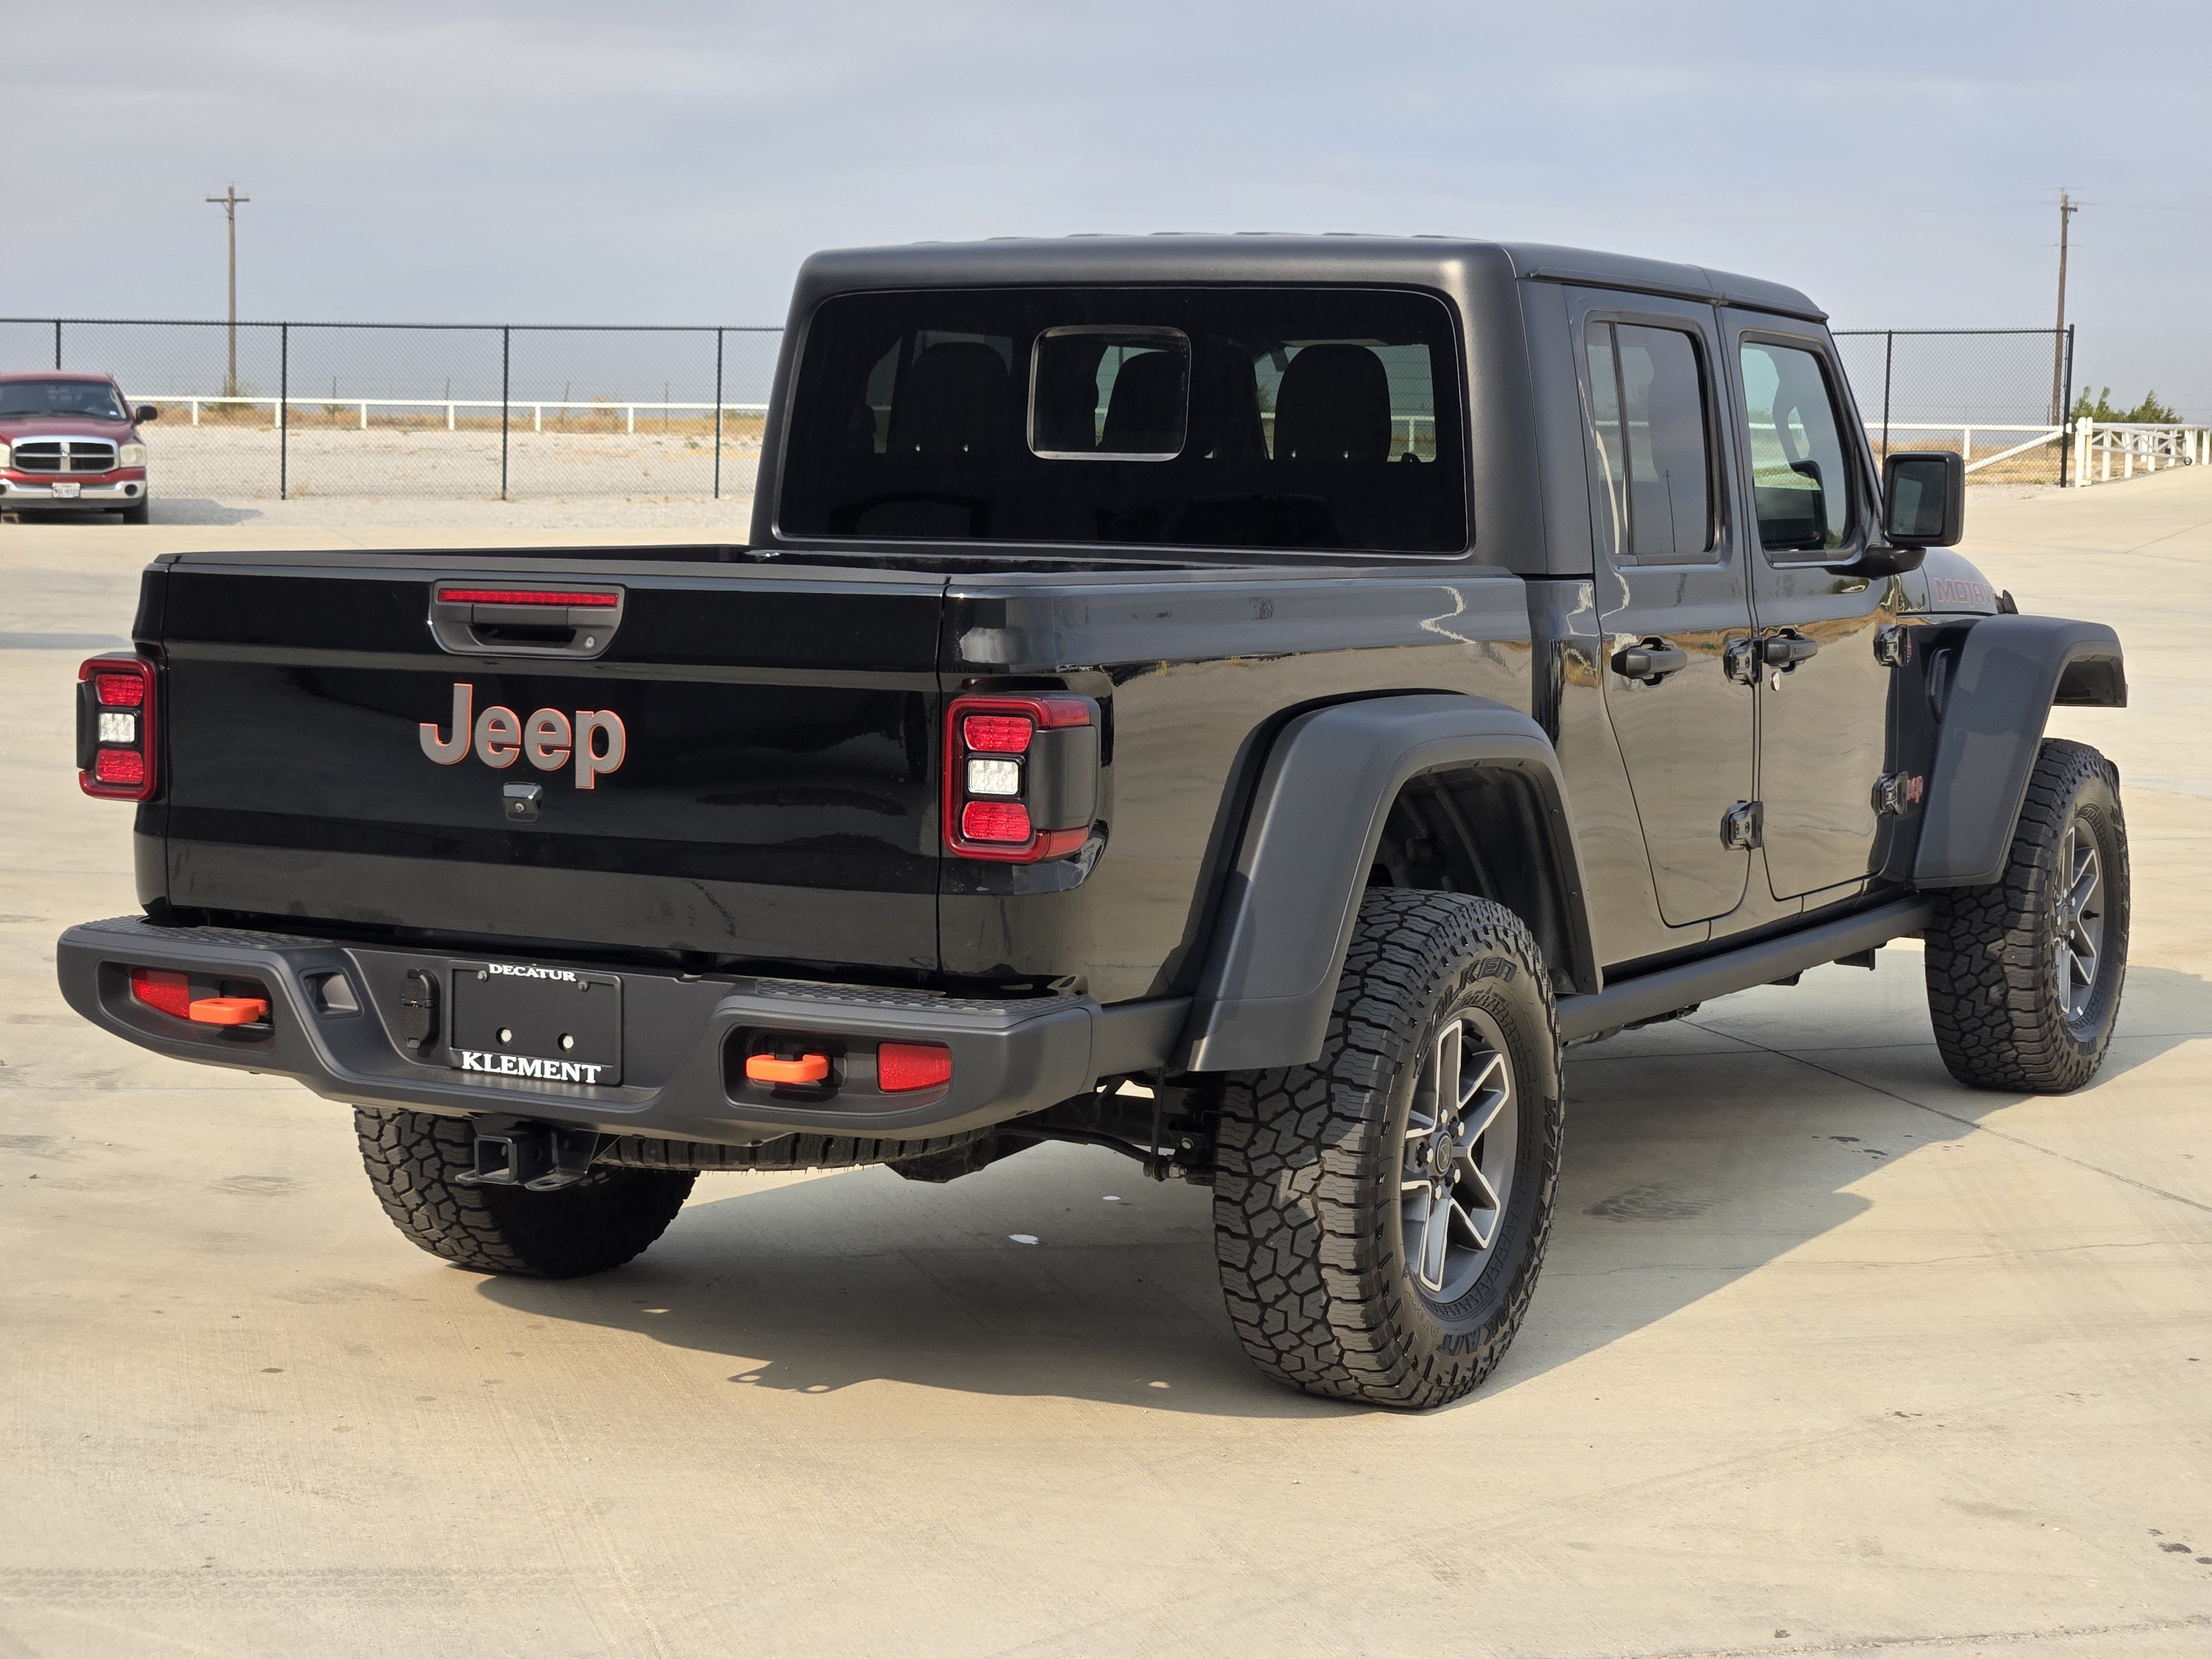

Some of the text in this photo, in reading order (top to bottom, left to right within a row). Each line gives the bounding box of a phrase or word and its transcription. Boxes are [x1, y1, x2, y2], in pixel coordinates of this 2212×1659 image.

[419, 683, 626, 789] Jeep
[488, 963, 577, 982] DECATUR
[461, 1051, 602, 1084] KLEMENT
